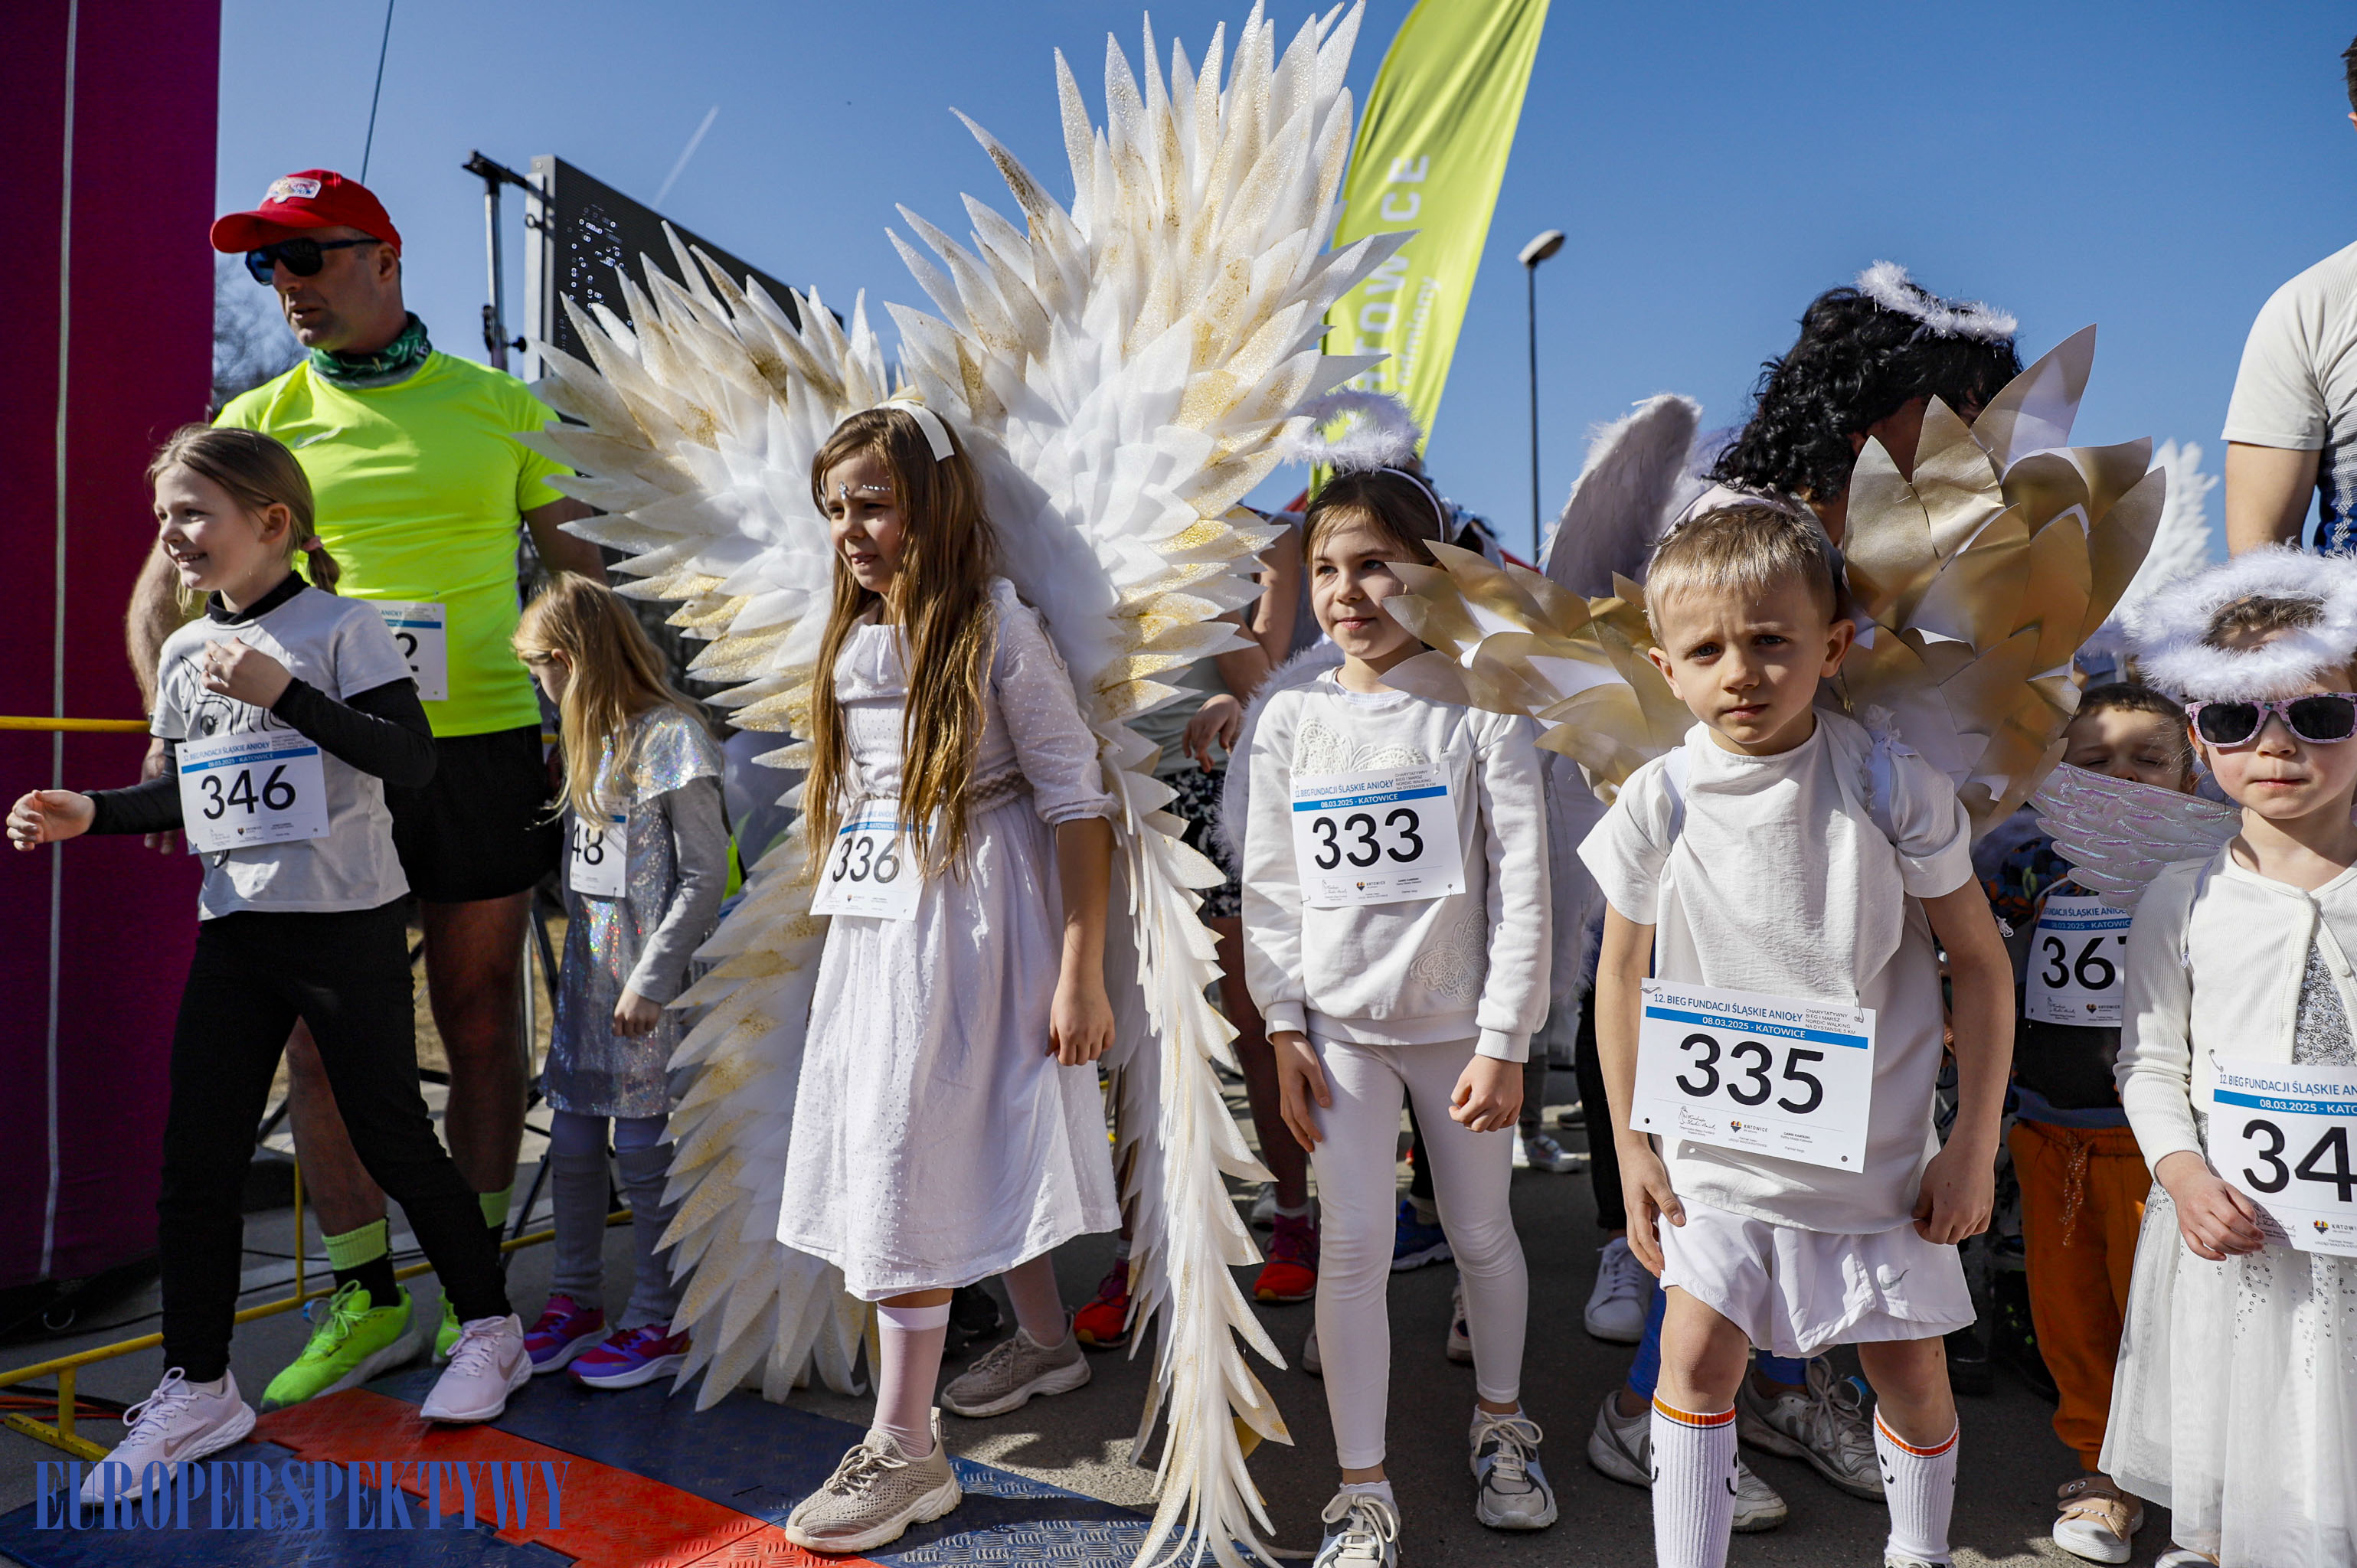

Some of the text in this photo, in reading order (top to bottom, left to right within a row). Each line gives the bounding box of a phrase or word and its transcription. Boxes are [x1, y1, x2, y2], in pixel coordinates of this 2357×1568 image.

[246, 741, 270, 750] ANIOŁY
[239, 753, 274, 763] KATOWICE
[201, 764, 296, 820] 346
[1301, 788, 1310, 797] BIEG
[1310, 786, 1338, 796] FUNDACJI
[1338, 782, 1365, 795] ŚLĄSKIE
[1366, 779, 1394, 791] ANIOŁY
[1320, 799, 1354, 808] 08.03.2025
[1358, 793, 1399, 805] KATOWICE
[1313, 807, 1424, 871] 333
[832, 835, 901, 884] 336
[2068, 907, 2099, 917] ŚLĄSKIE
[2091, 920, 2131, 929] KATOWIC
[2042, 936, 2127, 990] 36
[1654, 993, 1803, 1023] 12. BIEG FUNDACJI ŚLĄSKIE ANIOŁY
[1806, 1008, 1849, 1018] CHARYTATYWNY
[1702, 1017, 1749, 1030] 08.03.2025
[1756, 1024, 1806, 1038] KATOWICE
[1813, 1024, 1842, 1033] DYSTANSIE
[1675, 1033, 1824, 1115] 335
[2228, 1075, 2244, 1086] BIEG
[2244, 1078, 2290, 1093] FUNDACJI
[2292, 1080, 2340, 1096] ŚLĄSKIE
[2259, 1099, 2317, 1112] 08.03.2025
[1744, 1124, 1768, 1132] KATOWICE
